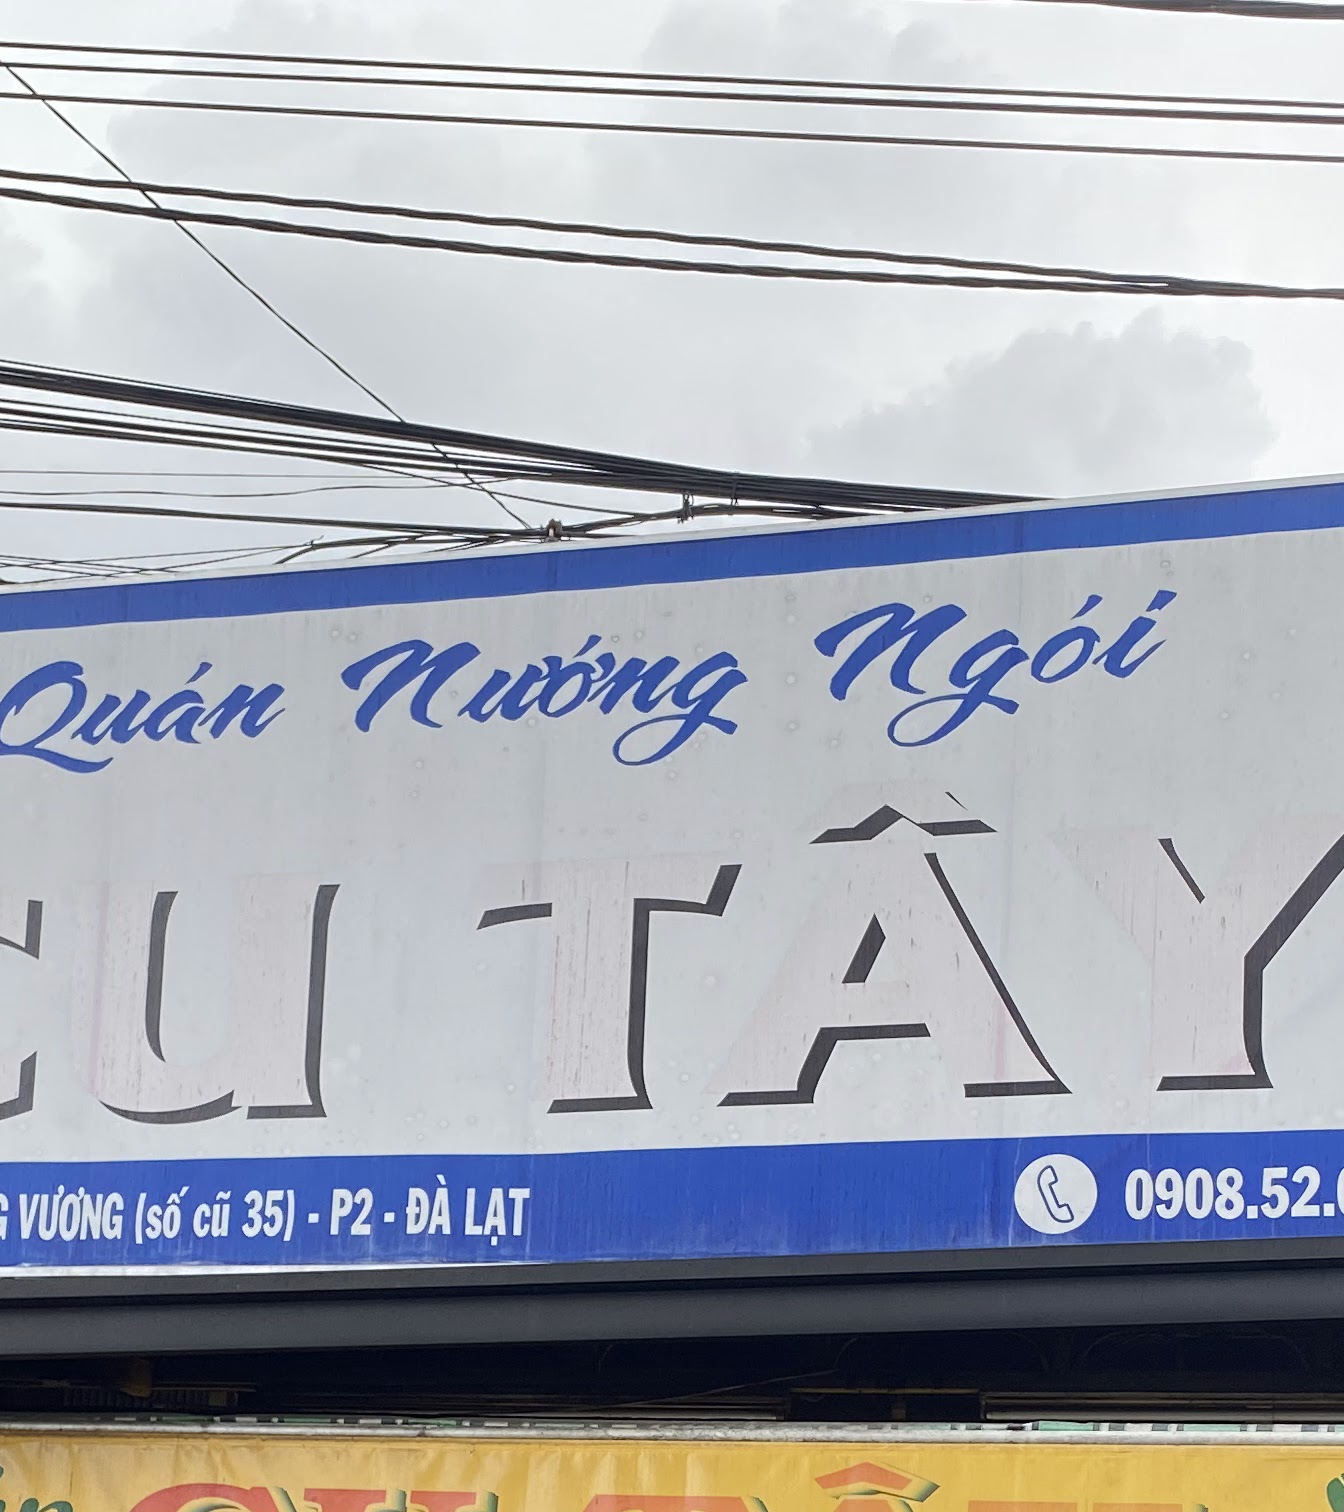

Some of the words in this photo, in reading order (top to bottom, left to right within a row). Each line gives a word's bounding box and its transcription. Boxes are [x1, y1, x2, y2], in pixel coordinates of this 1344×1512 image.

[342, 635, 748, 766] Nướng
[814, 588, 1178, 748] Ngói
[18, 1184, 125, 1242] VƯƠNG
[134, 1186, 190, 1245] (số
[192, 1190, 232, 1238] cũ
[242, 1189, 296, 1242] 35)
[329, 1188, 373, 1236] P2
[406, 1174, 452, 1236] ĐÀ
[464, 1187, 531, 1246] LẠT
